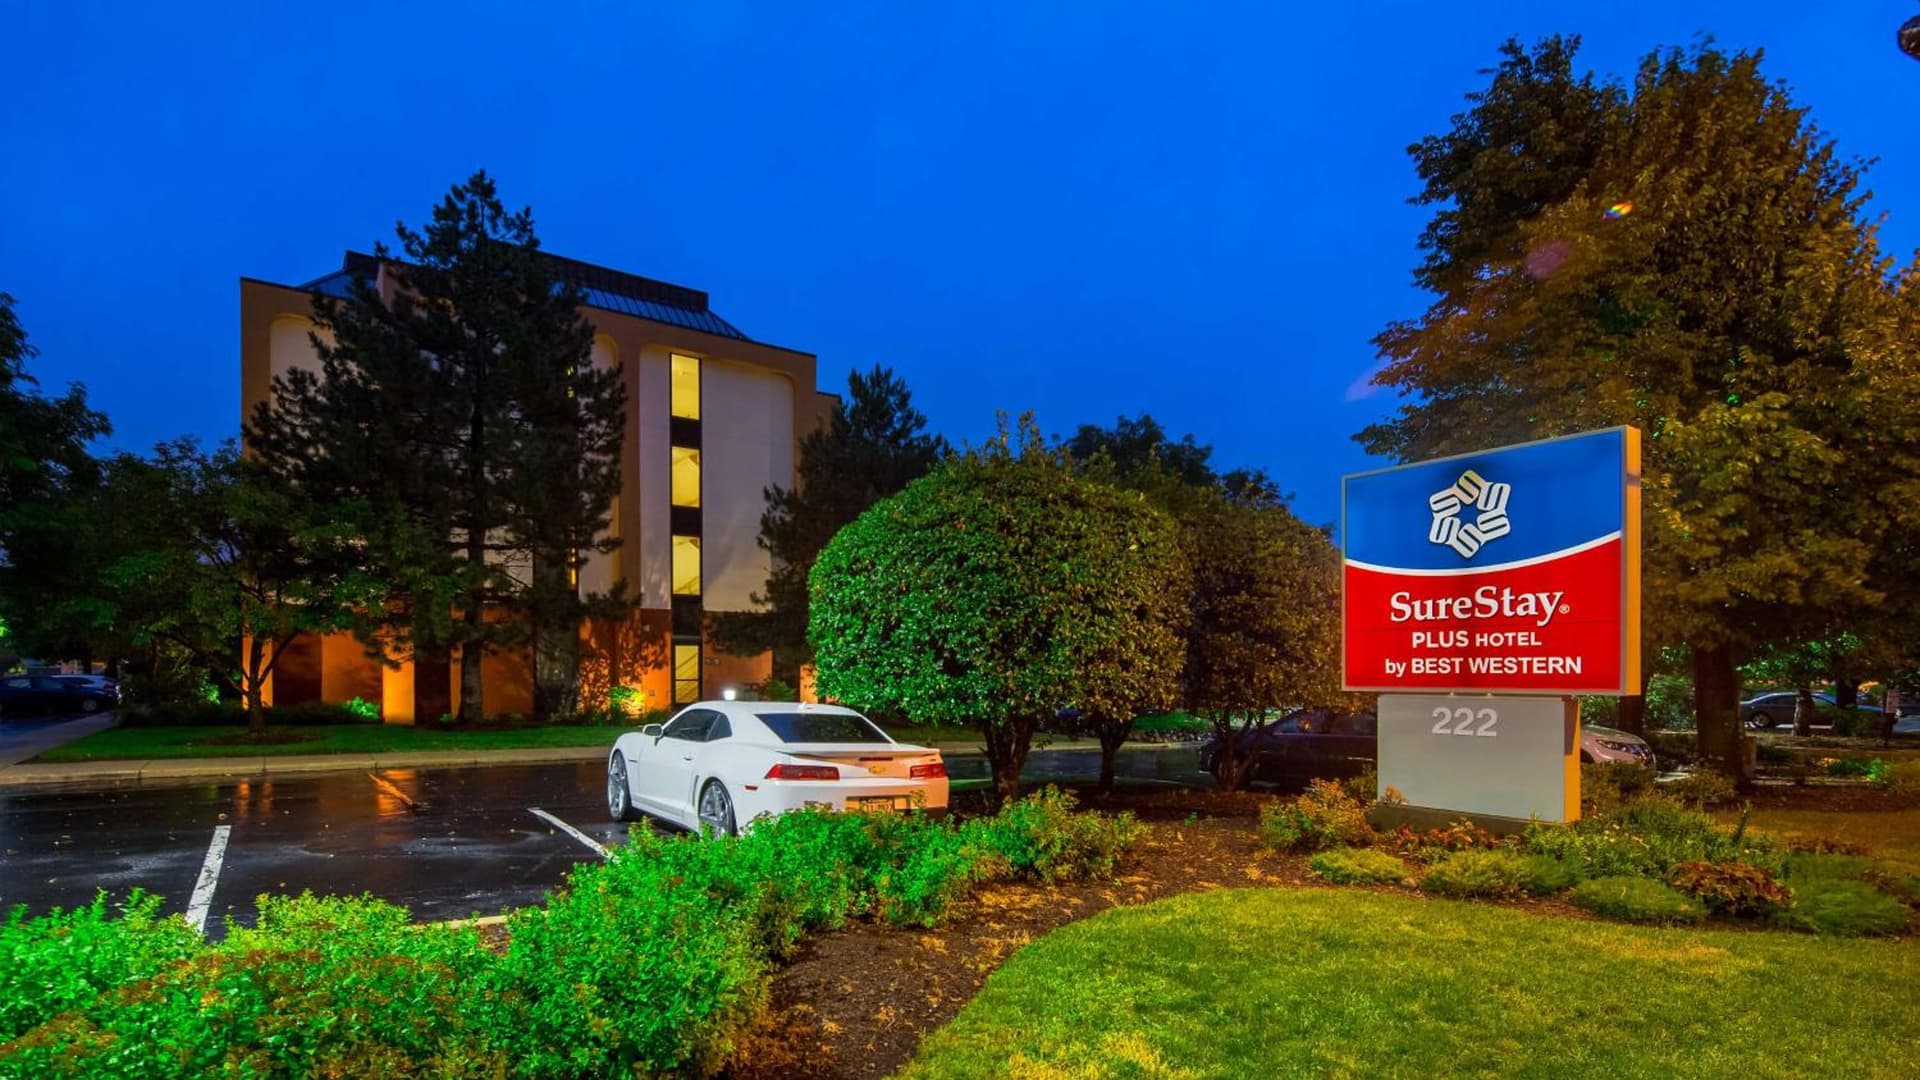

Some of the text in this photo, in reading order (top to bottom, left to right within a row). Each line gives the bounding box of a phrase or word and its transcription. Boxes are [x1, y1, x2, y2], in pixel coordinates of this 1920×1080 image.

[1411, 630, 1542, 649] PLUS HOTEL
[1385, 656, 1582, 678] by BEST WESTERN
[1431, 707, 1498, 737] 222
